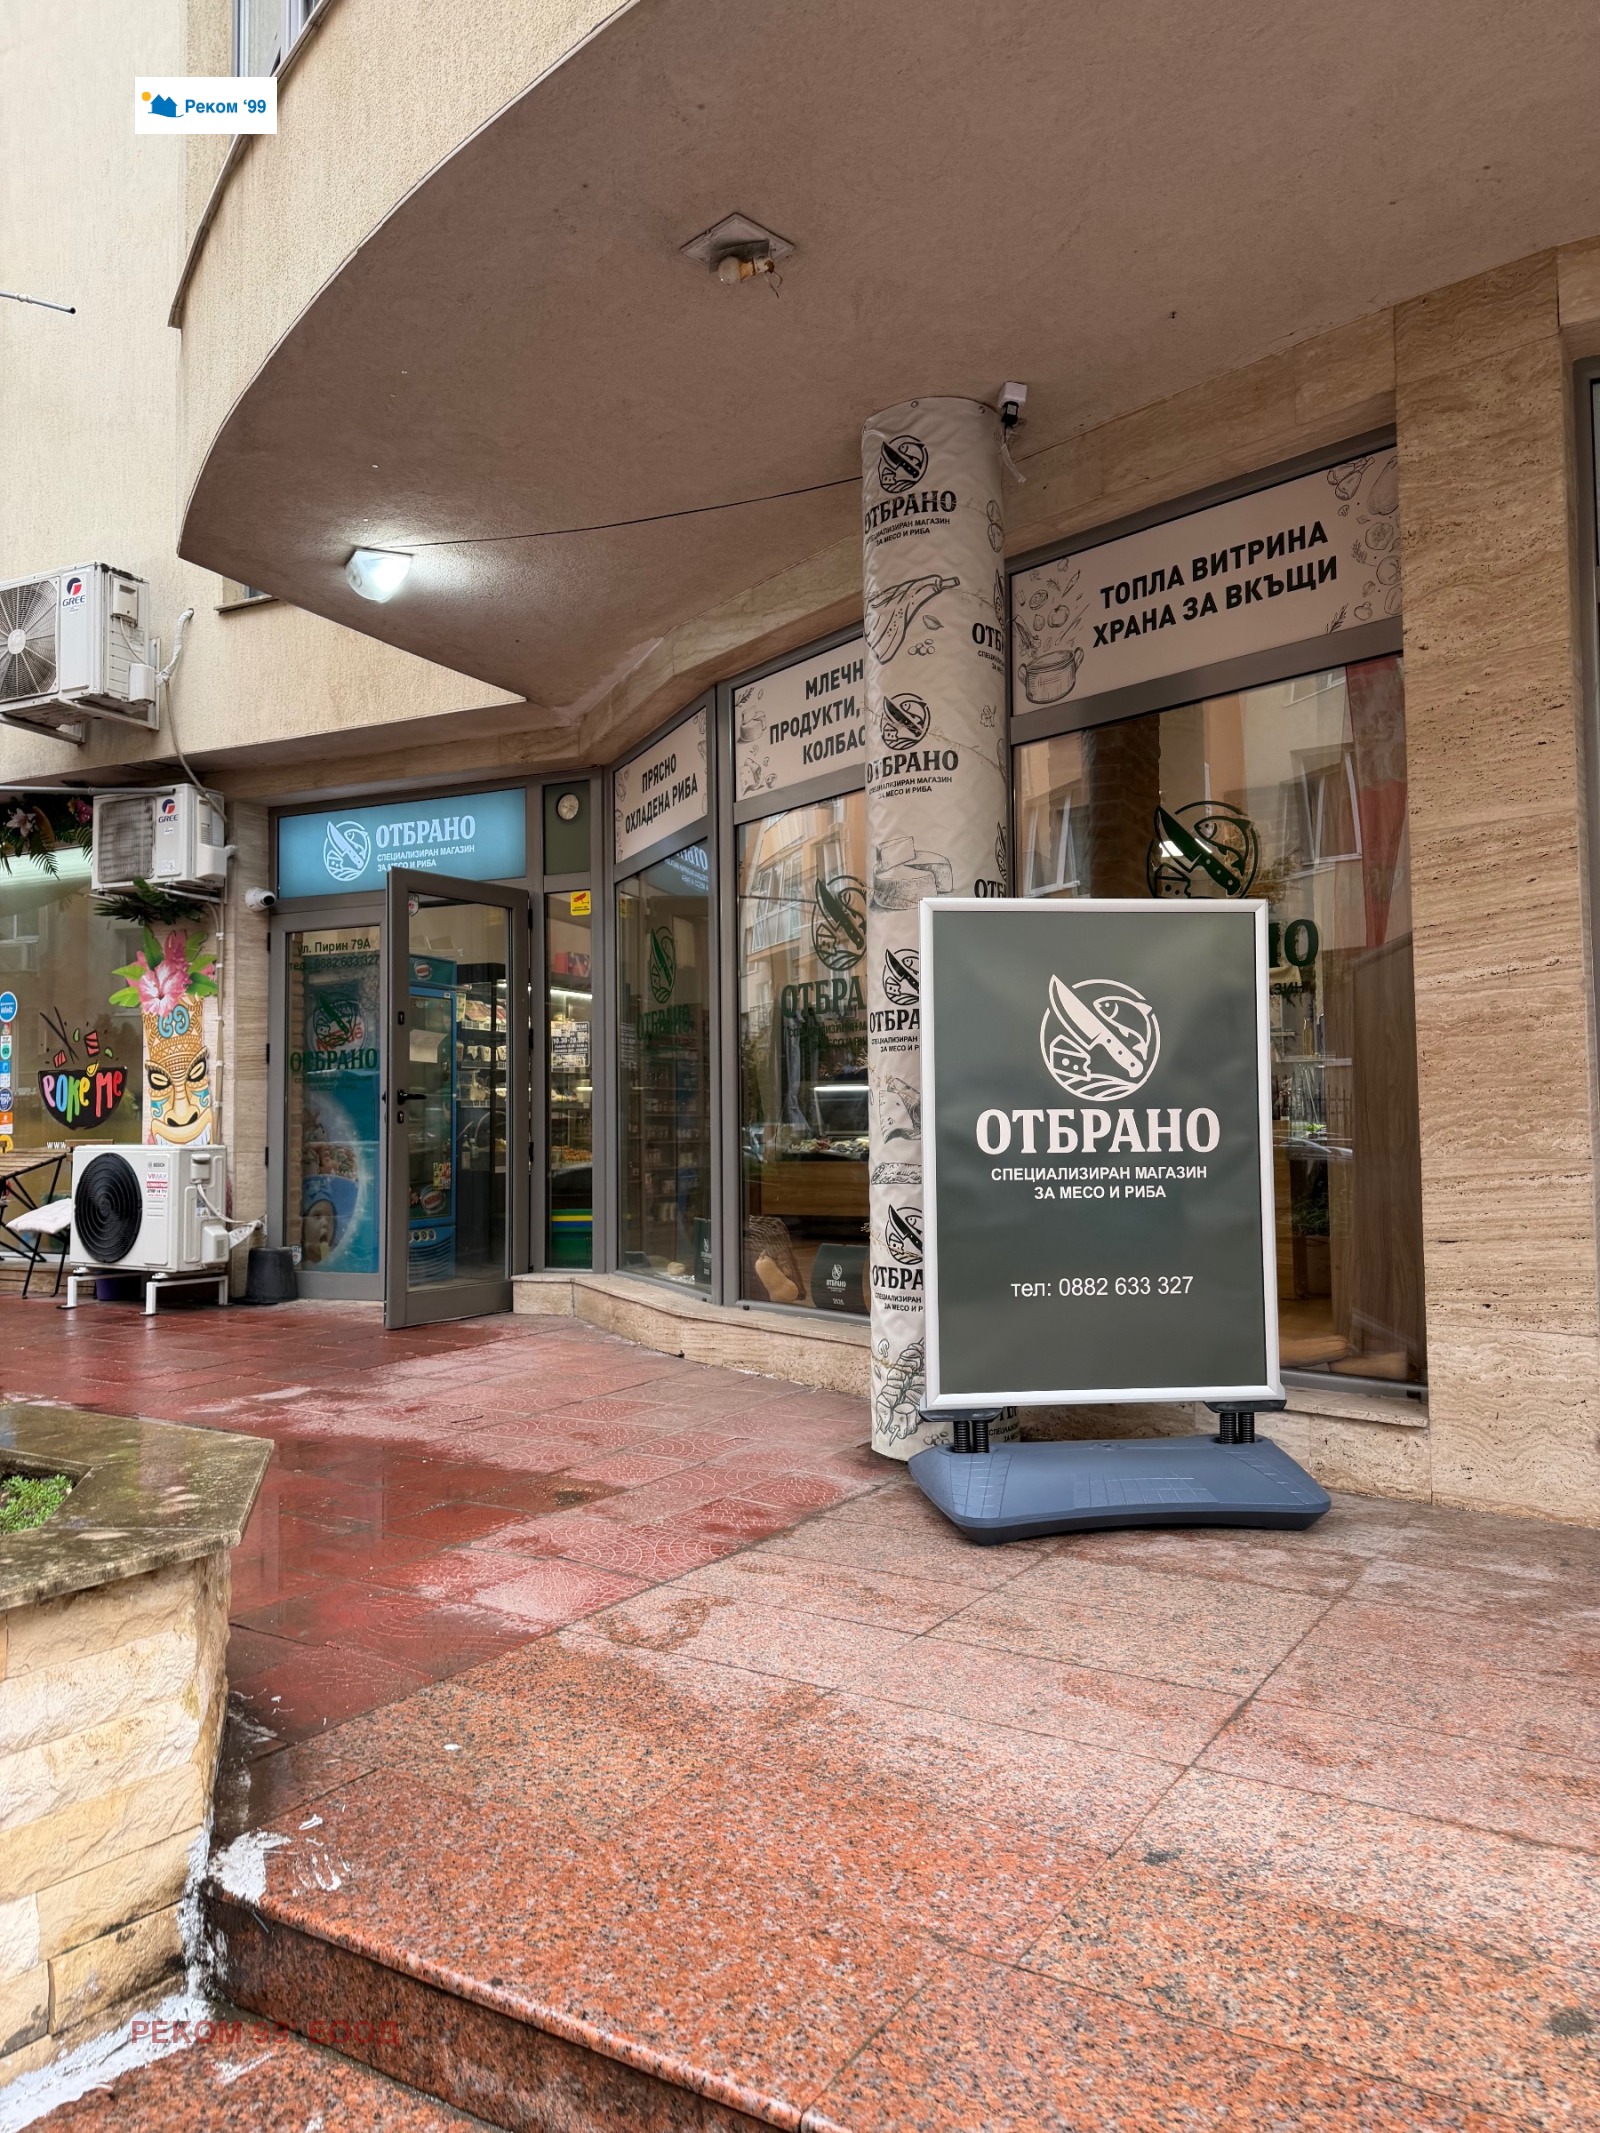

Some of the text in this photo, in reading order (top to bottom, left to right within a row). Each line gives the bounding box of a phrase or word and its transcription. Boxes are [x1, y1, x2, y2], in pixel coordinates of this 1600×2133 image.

[865, 490, 957, 534] ОТБРАНО
[915, 517, 951, 526] МАГАЗИН
[910, 527, 930, 536] РИБА
[1100, 520, 1328, 609] ТОПЛА ВИТРИНА
[62, 594, 86, 607] GREE
[1092, 555, 1338, 648] ХРАНА ЗА ВКЪЩИ
[769, 696, 860, 745] ПРОДУКТИ,
[642, 753, 677, 794] ПРЯСНО
[867, 749, 958, 783] ОТБРАНО
[916, 776, 952, 784] МАГАЗИН
[885, 788, 904, 798] МЕСО
[912, 785, 932, 794] РИБА
[625, 773, 698, 834] ОХЛАДЕНА РИБА
[158, 814, 179, 823] GREE
[375, 815, 476, 848] ОТБРАНО
[377, 845, 475, 862] СПЕЦИАЛИЗИРАН МАГАЗИН
[377, 864, 387, 872] ЗА
[416, 859, 437, 868] РИБА
[315, 942, 348, 954] Пирин
[341, 956, 359, 967] 633
[361, 955, 380, 966] 327
[781, 976, 865, 1019] ОТБРА
[976, 1107, 1221, 1155] ОТБРАНО
[991, 1166, 1207, 1183] СПЕЦИАЛИЗИРАН МАГАЗИН
[1034, 1185, 1166, 1200] ЗА МЕСО И РИБА
[1010, 1276, 1194, 1298] тел: 0882 633 327
[892, 1303, 909, 1312] МЕСО
